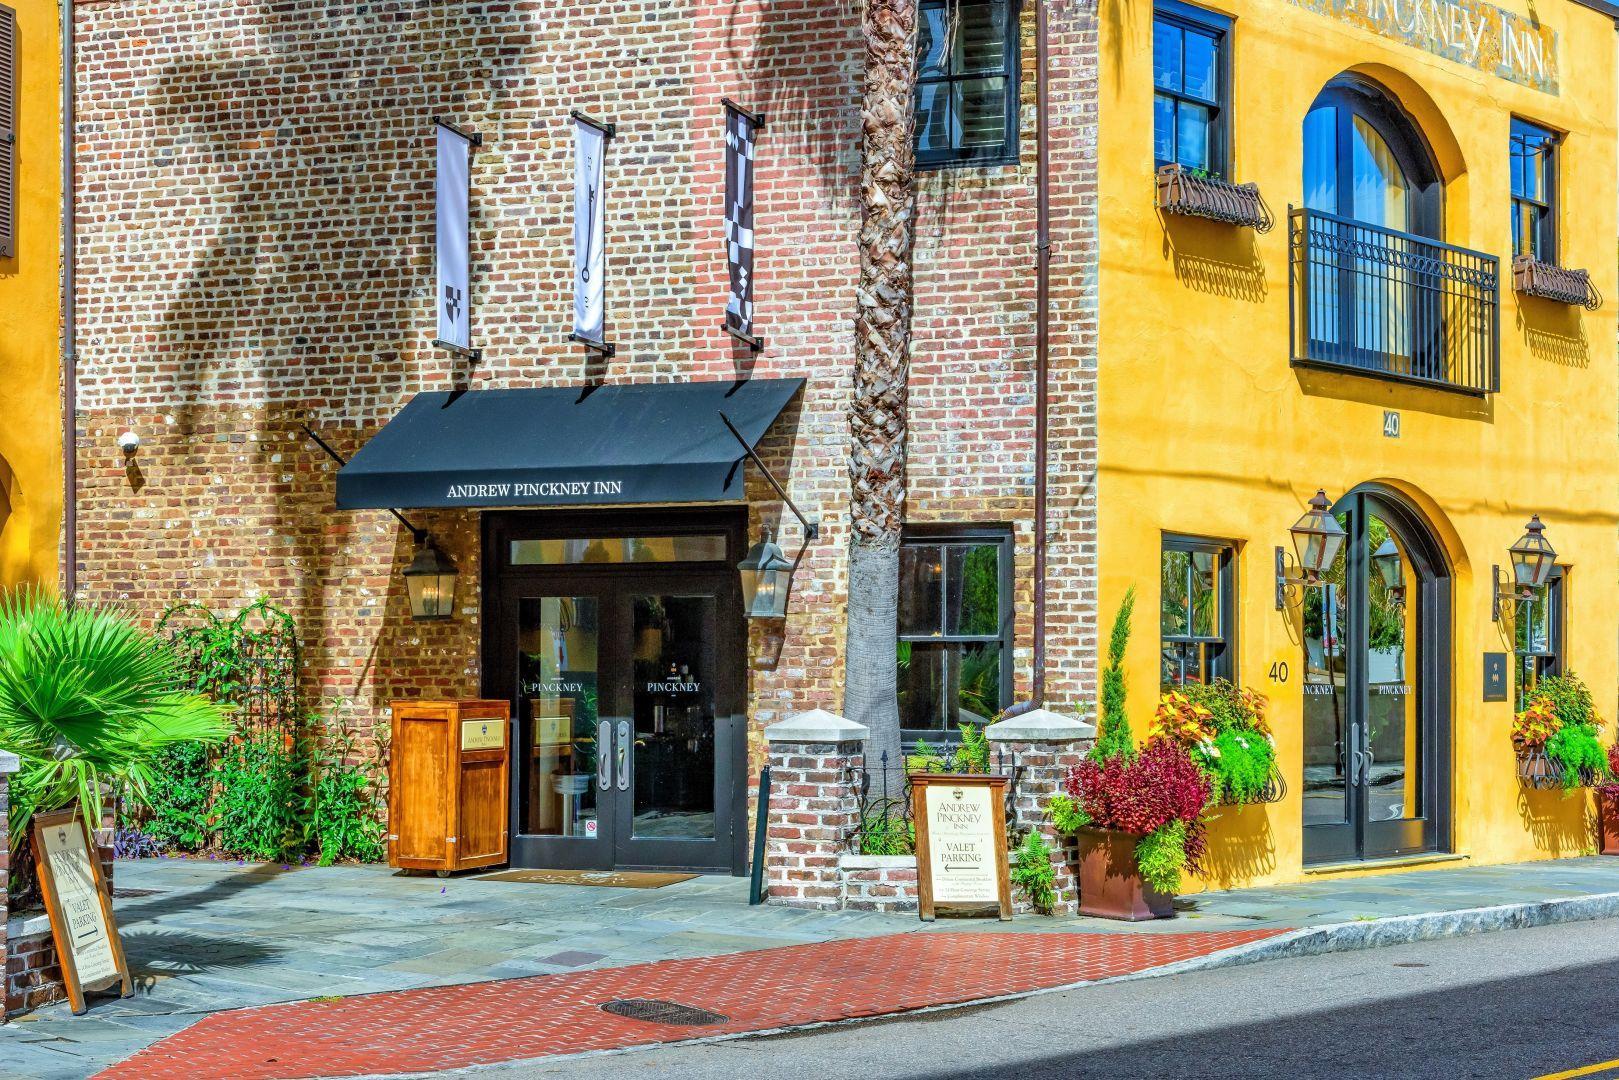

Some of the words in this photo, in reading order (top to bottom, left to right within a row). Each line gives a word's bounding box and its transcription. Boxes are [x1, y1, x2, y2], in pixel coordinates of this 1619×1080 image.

[1500, 13, 1544, 80] INN
[1384, 413, 1399, 435] 40
[447, 483, 511, 498] ANDREW
[513, 481, 591, 497] PINCKNEY
[593, 480, 622, 494] INN
[1268, 661, 1288, 682] 40
[532, 682, 583, 692] PINCKNEY
[647, 682, 701, 692] PINCKNEY
[1302, 684, 1335, 695] INCKNEY
[1379, 685, 1413, 695] PINCKNEY
[938, 802, 981, 813] ANDREW
[936, 812, 982, 824] PINCKNEY
[946, 842, 976, 852] VALET
[941, 853, 982, 863] PARKING
[72, 899, 91, 914] VALET
[72, 911, 97, 931] PARKING
